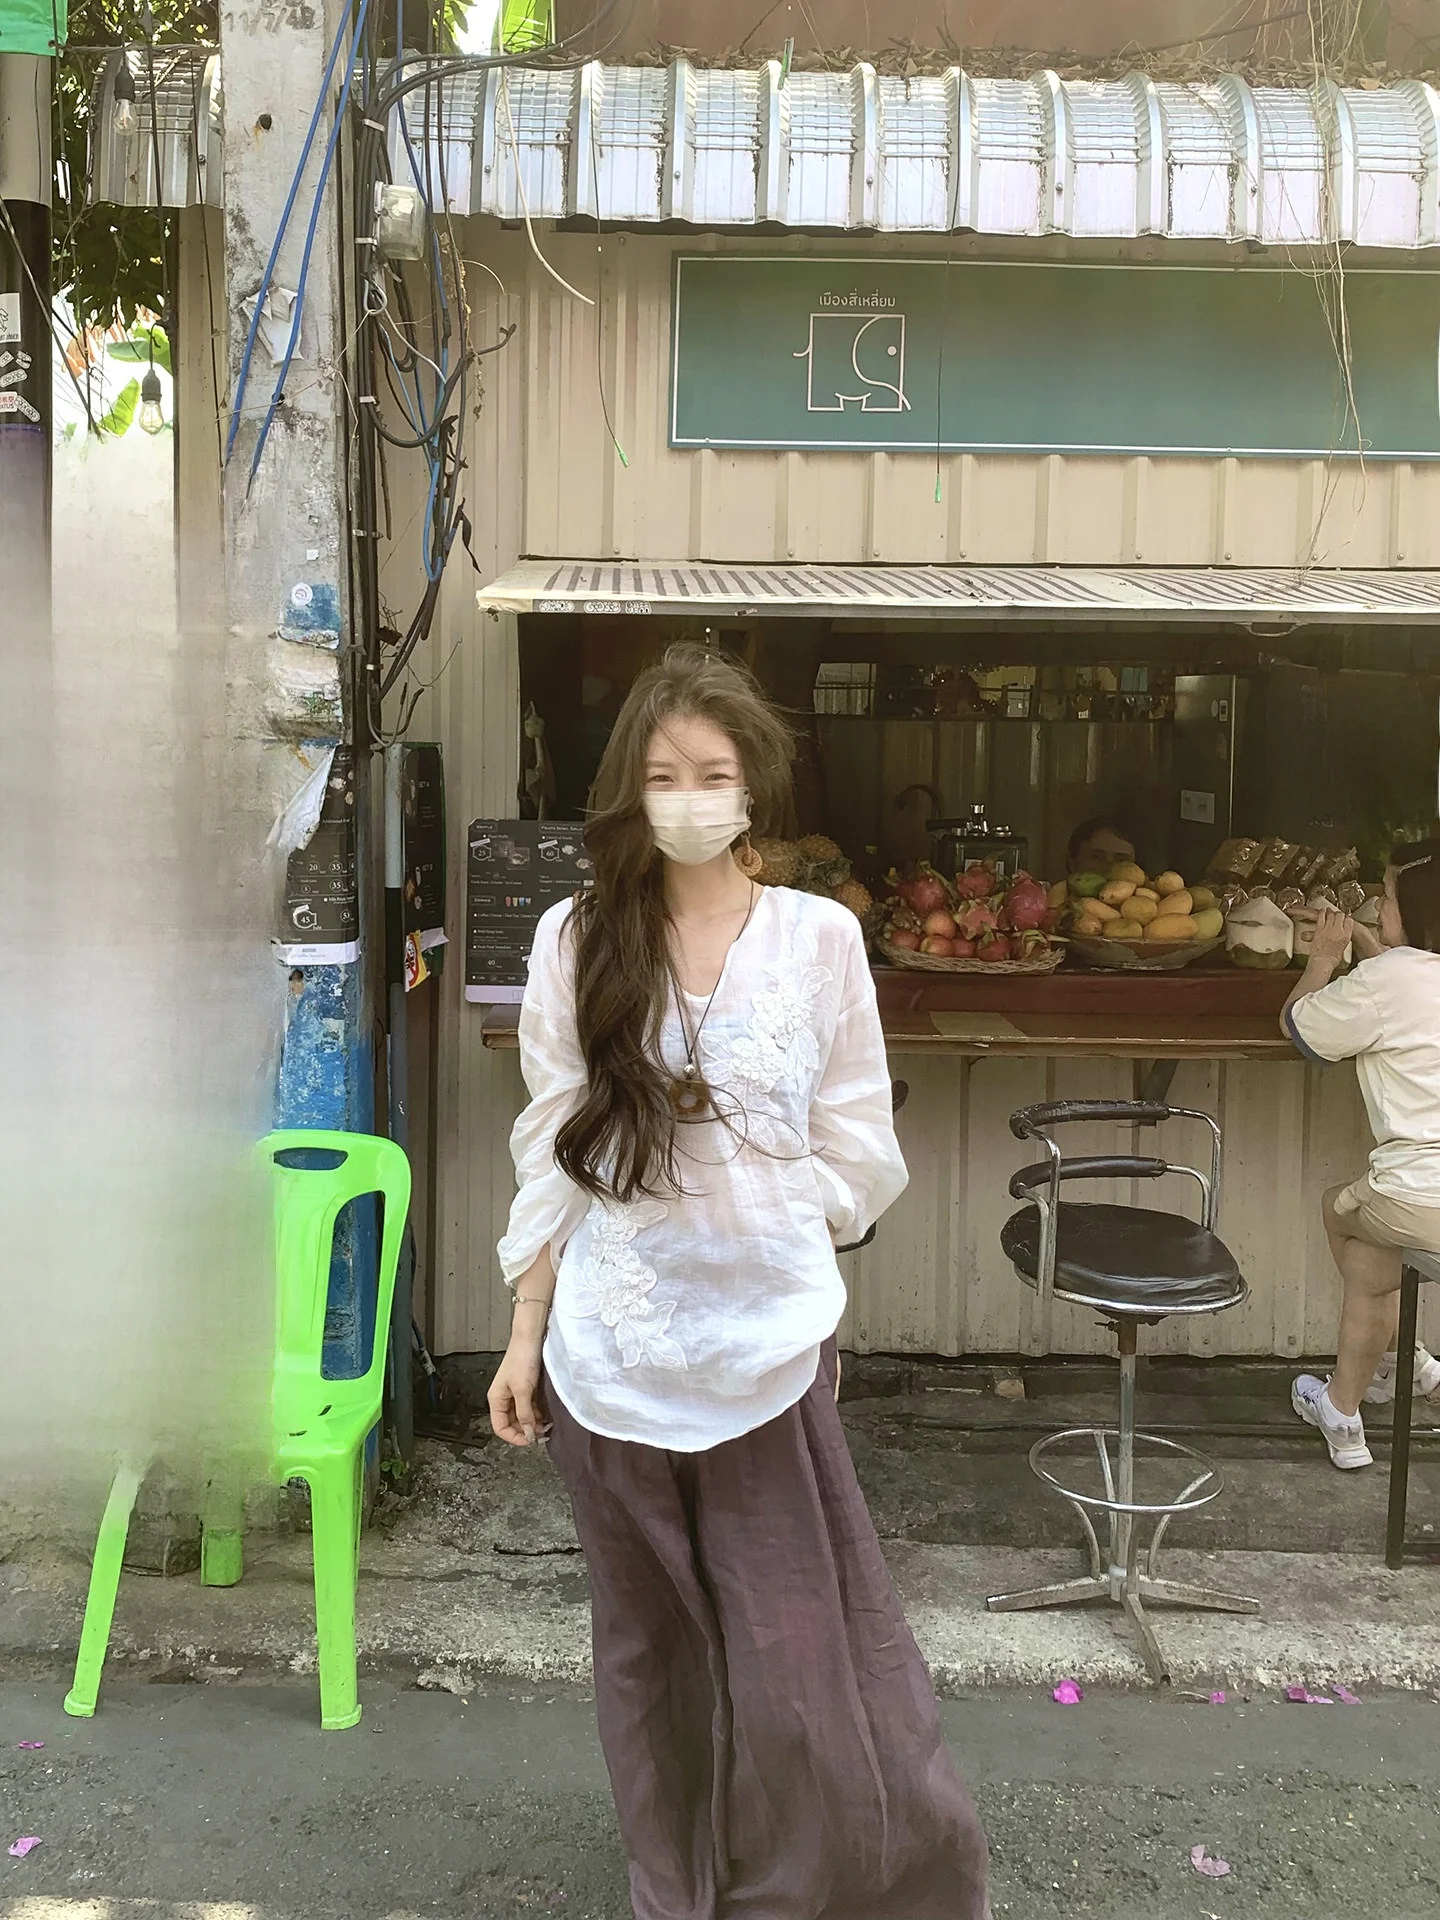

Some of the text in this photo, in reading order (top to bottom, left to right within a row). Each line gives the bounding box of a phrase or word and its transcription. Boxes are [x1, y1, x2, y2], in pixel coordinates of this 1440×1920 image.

[819, 287, 896, 307] เมืองสี่เหลี่ยม
